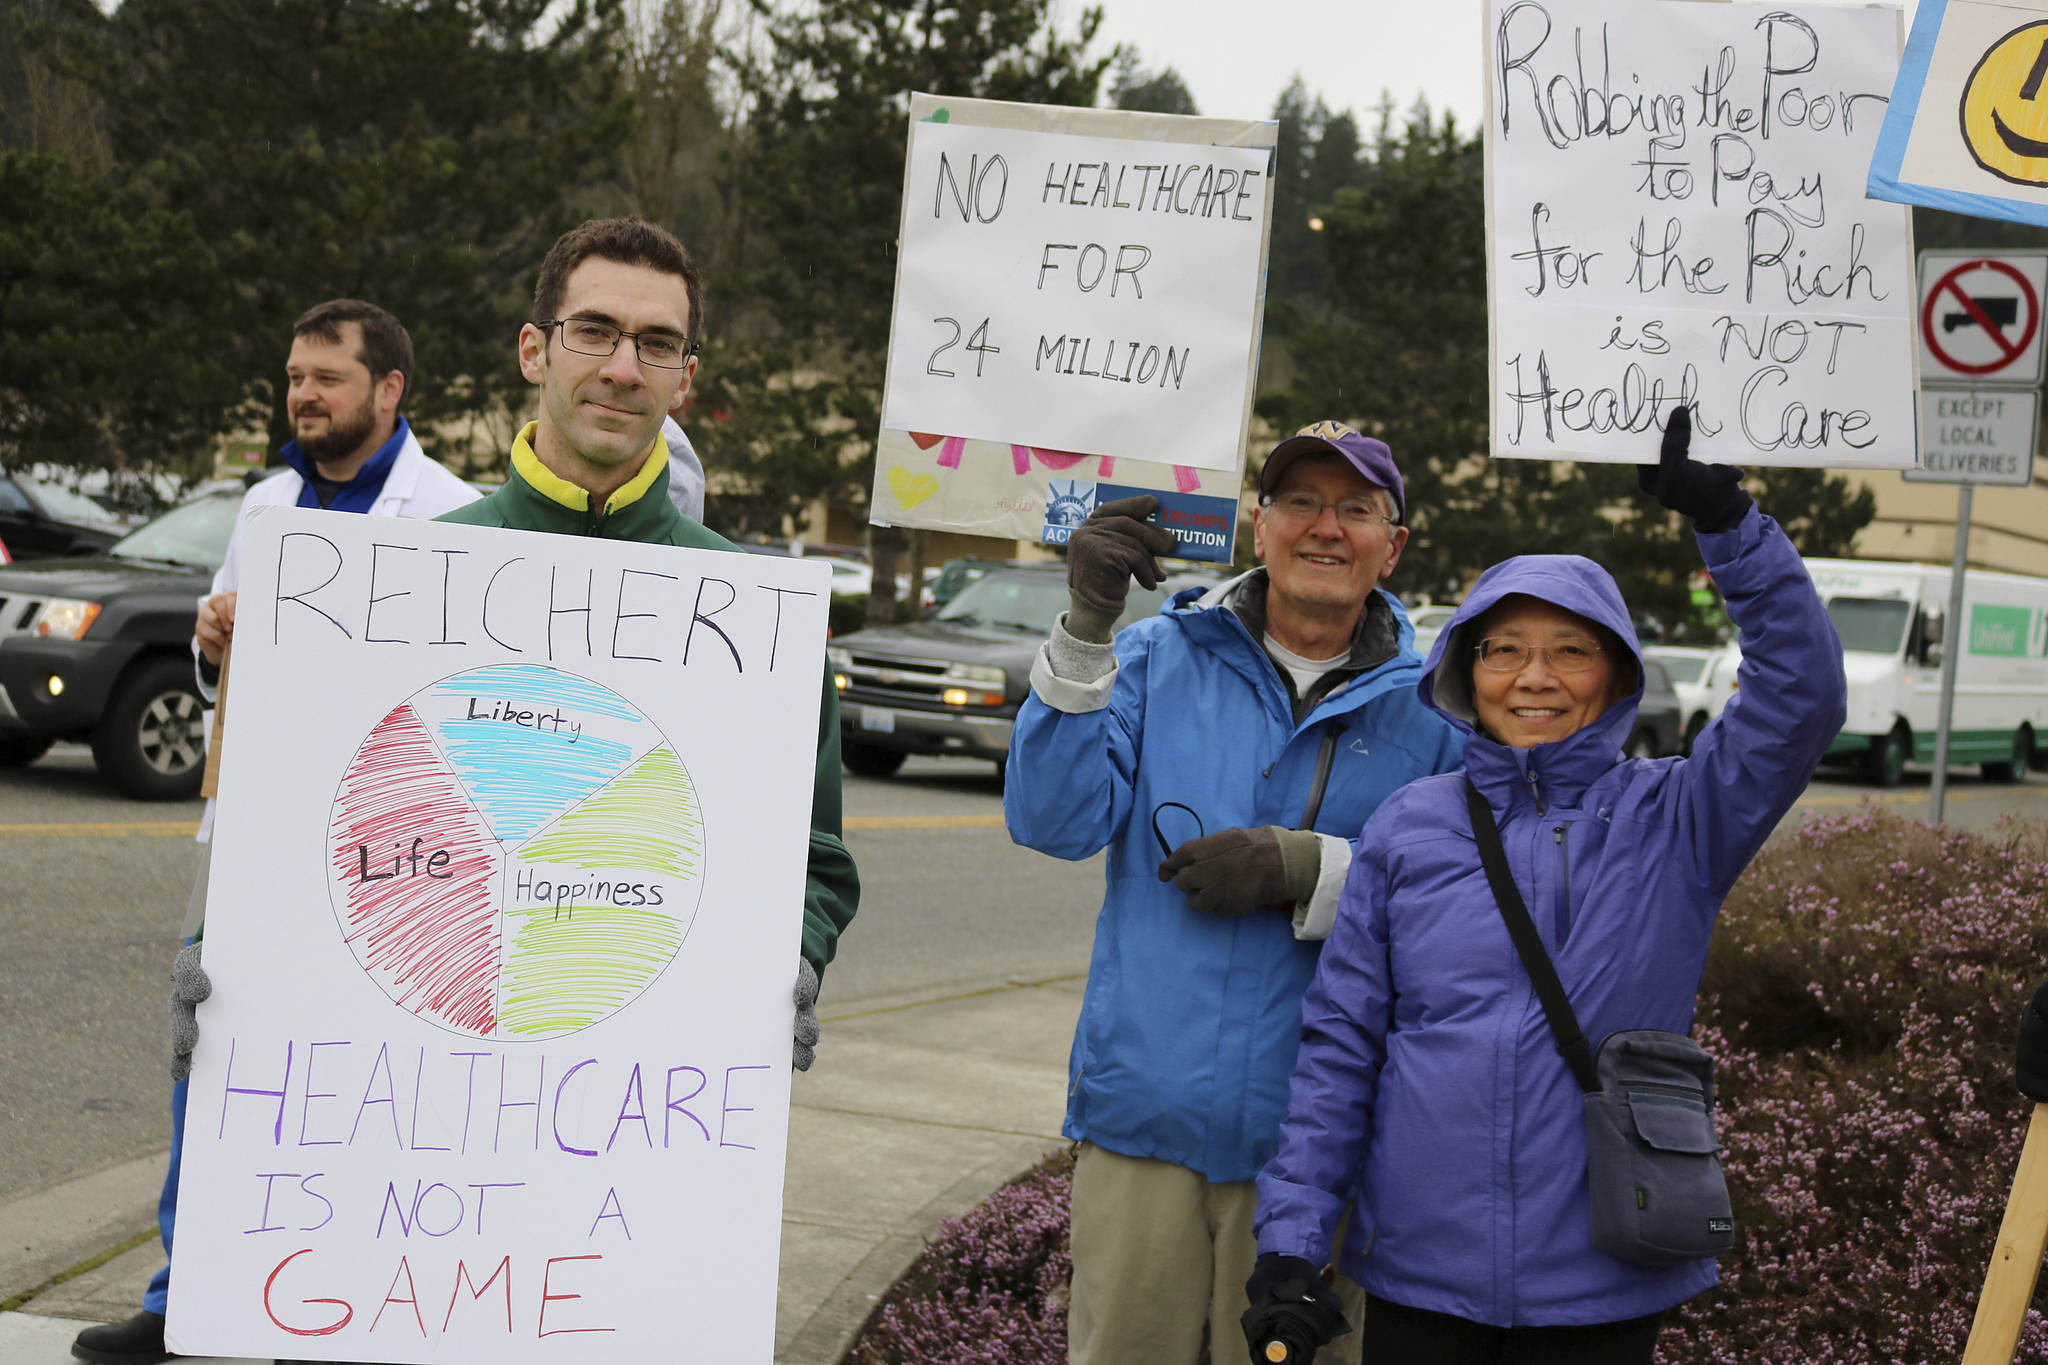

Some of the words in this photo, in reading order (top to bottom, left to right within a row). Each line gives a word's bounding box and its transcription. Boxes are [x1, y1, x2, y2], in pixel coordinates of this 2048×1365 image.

[1497, 0, 1686, 150] Robbing
[1691, 46, 1758, 132] the
[1755, 11, 1889, 140] Poor
[934, 151, 1009, 224] NO
[1042, 161, 1261, 222] HEALTHCARE
[1632, 135, 1694, 200] to
[1711, 133, 1825, 229] Pay
[1036, 243, 1152, 300] FOR
[1511, 202, 1603, 298] for
[1626, 215, 1729, 294] the
[1745, 207, 1889, 306] Rich
[926, 316, 1001, 378] 24
[1035, 334, 1191, 391] MILLION
[1600, 315, 1671, 354] is
[1712, 315, 1867, 375] NOT
[1506, 349, 1723, 447] Health
[1739, 365, 1880, 452] Care
[1938, 398, 2005, 418] EXCEPT
[1940, 426, 1996, 446] LOCAL
[1161, 509, 1229, 530] TRUMPS
[1164, 527, 1226, 547] ITUTION
[274, 532, 818, 673] REICHERT
[467, 698, 583, 743] Liberty
[359, 838, 453, 884] Life
[516, 868, 664, 921] Happiness
[218, 1038, 772, 1157] HEALTHCARE
[243, 1173, 334, 1234] IS
[377, 1179, 526, 1238] NOT
[589, 1187, 632, 1240] A
[264, 1249, 616, 1338] GAME
